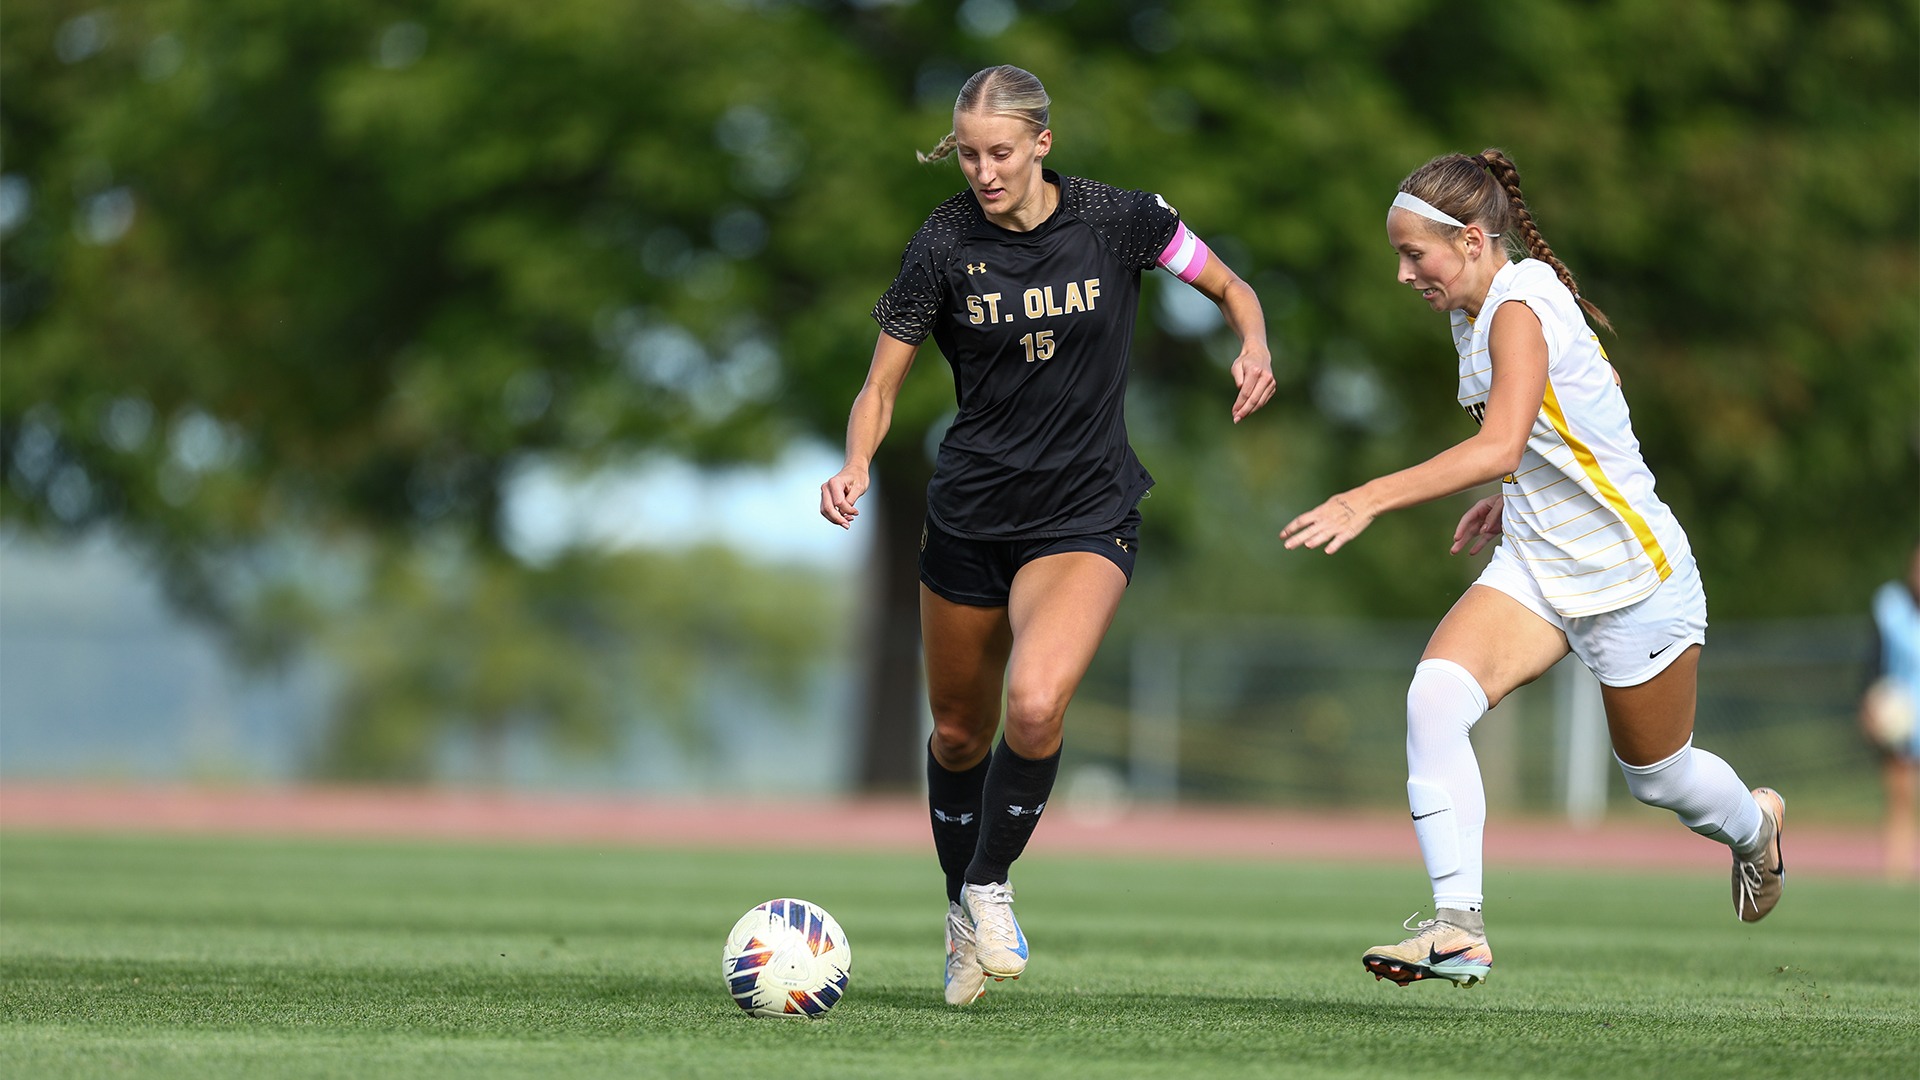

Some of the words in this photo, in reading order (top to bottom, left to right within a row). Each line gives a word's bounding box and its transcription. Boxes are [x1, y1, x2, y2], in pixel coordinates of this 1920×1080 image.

[966, 292, 1014, 325] ST.
[1023, 278, 1101, 320] OLAF
[1019, 330, 1056, 363] 15
